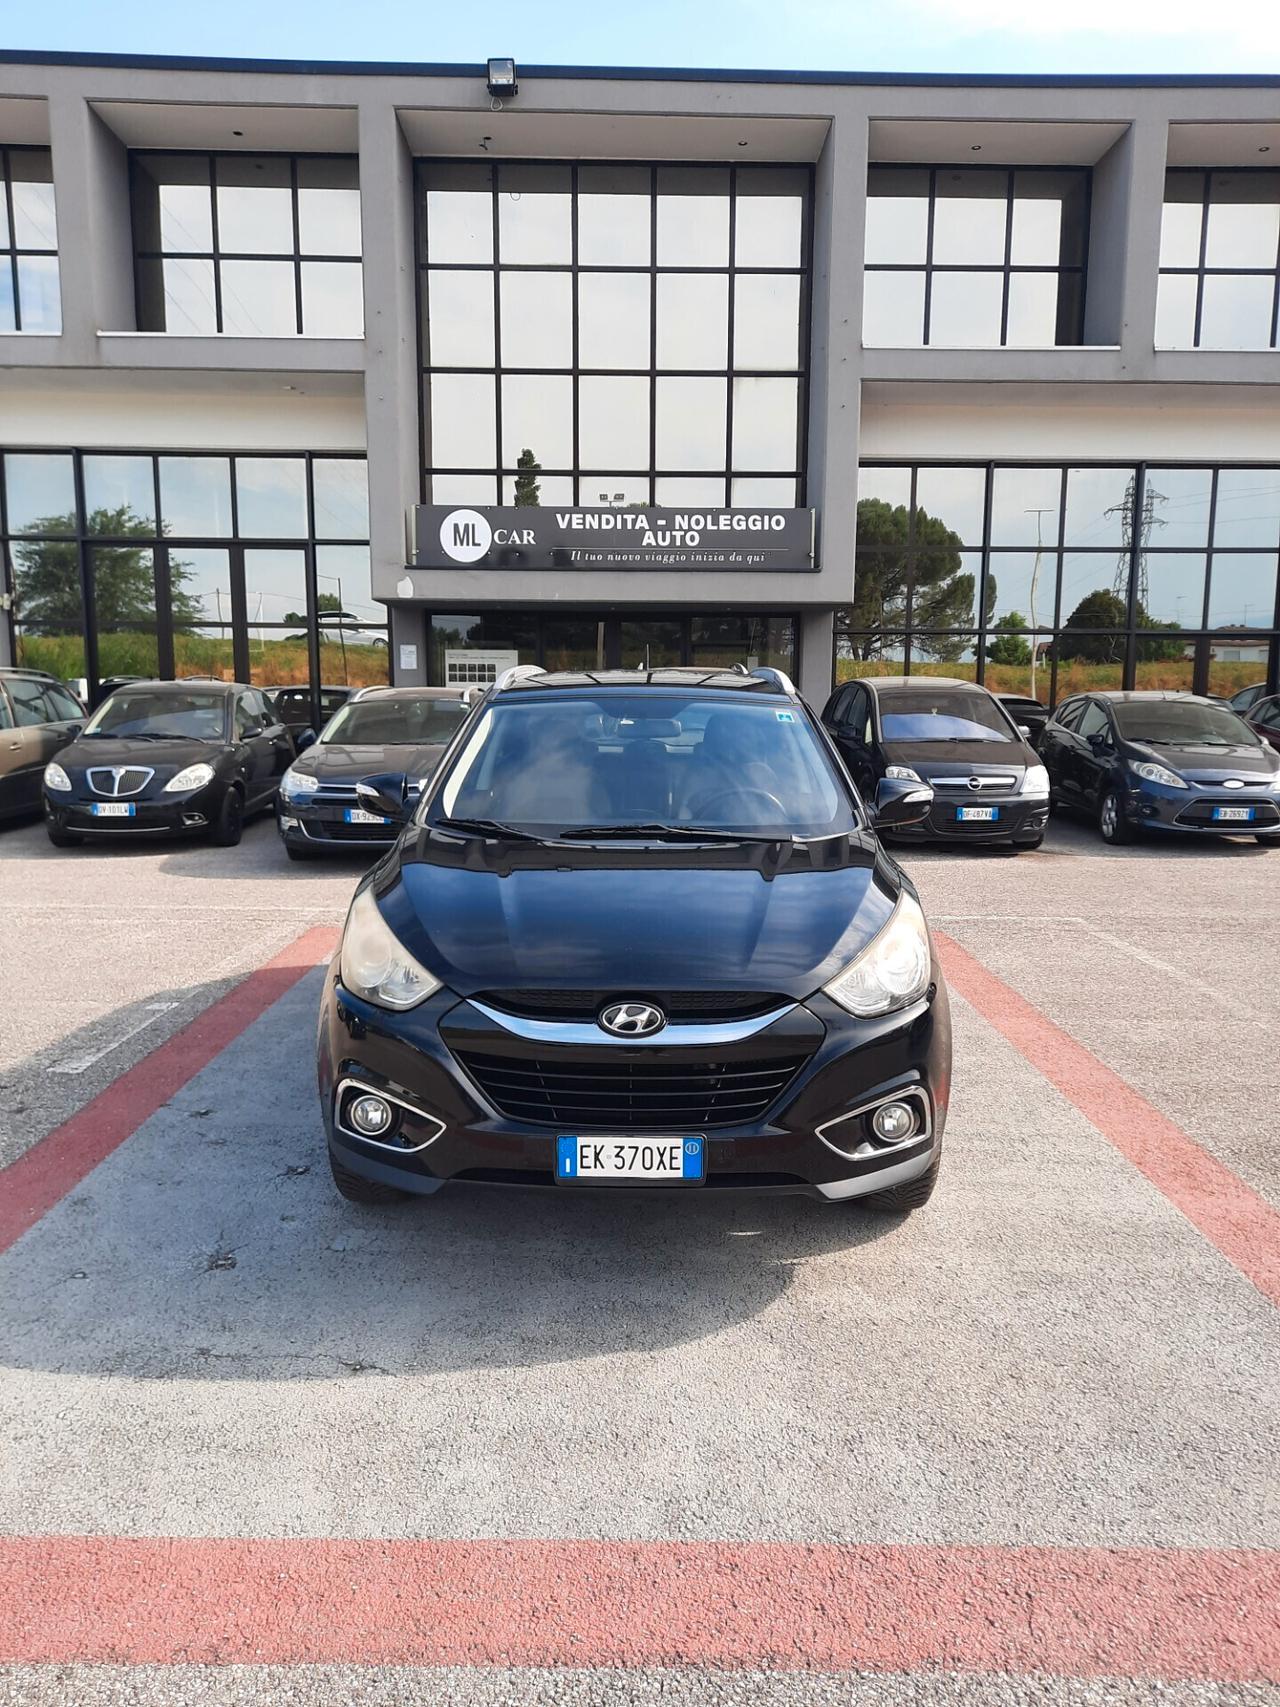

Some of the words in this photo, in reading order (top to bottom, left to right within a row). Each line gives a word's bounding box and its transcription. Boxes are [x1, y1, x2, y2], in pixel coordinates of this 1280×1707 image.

[556, 513, 649, 530] VENDITA
[675, 515, 785, 531] NOLEGGIO
[453, 522, 481, 547] ML
[493, 529, 536, 545] CAR
[642, 530, 700, 547] AUTO
[585, 551, 603, 561] tuo
[607, 553, 641, 562] nuovo
[645, 552, 686, 564] viaggio
[691, 552, 724, 562] inizia
[729, 552, 742, 562] da
[746, 552, 766, 564] qui
[579, 1145, 605, 1169] EK
[614, 1146, 681, 1170] 370XE
